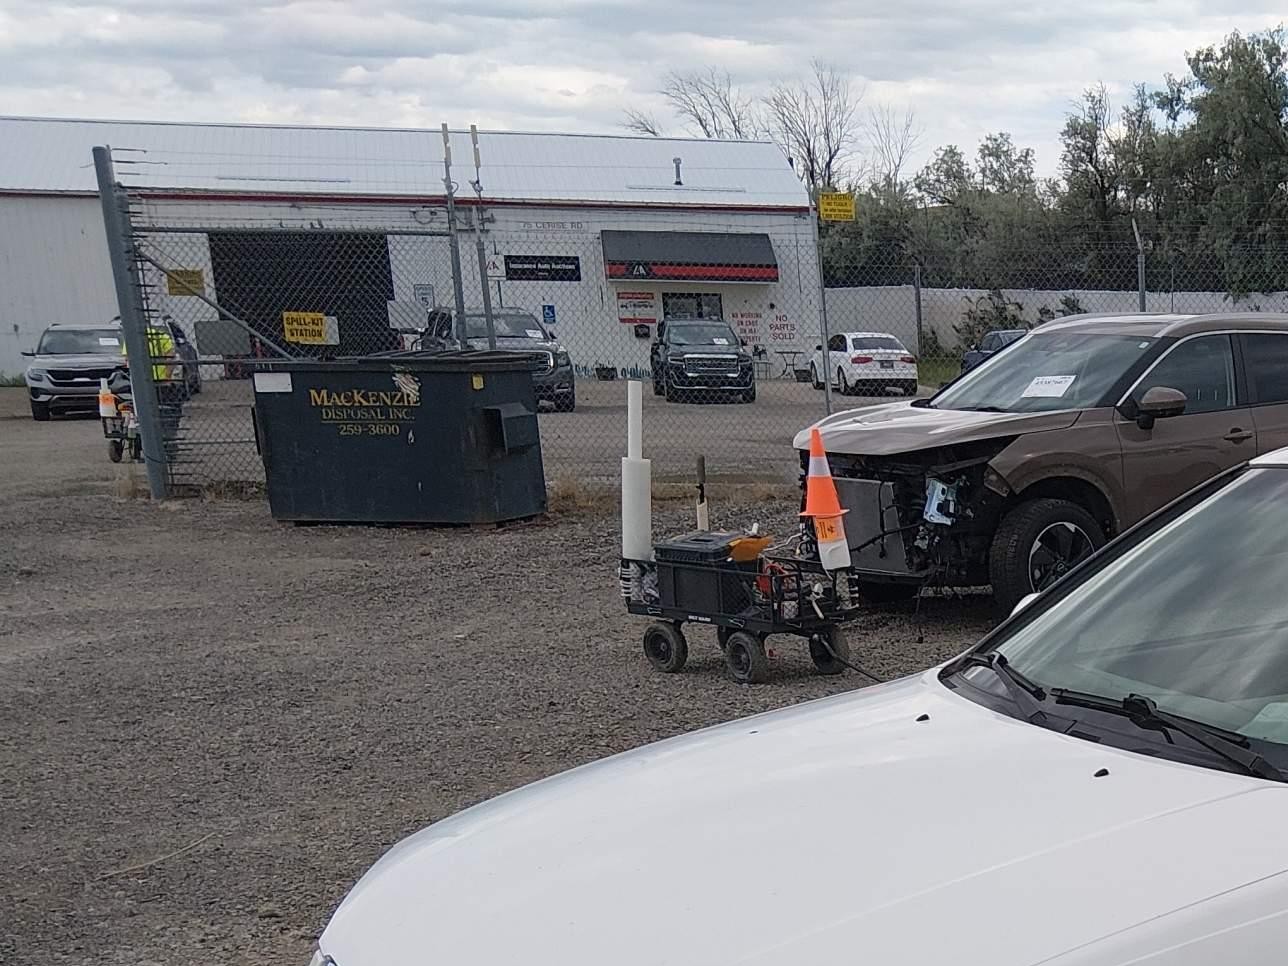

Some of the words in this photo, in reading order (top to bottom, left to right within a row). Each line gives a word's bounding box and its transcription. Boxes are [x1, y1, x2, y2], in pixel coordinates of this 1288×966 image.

[769, 323, 796, 331] PARTS
[772, 332, 795, 340] SOLD
[322, 408, 385, 420] DISPOSAL
[389, 409, 415, 420] INC.
[339, 424, 400, 436] 259-3600
